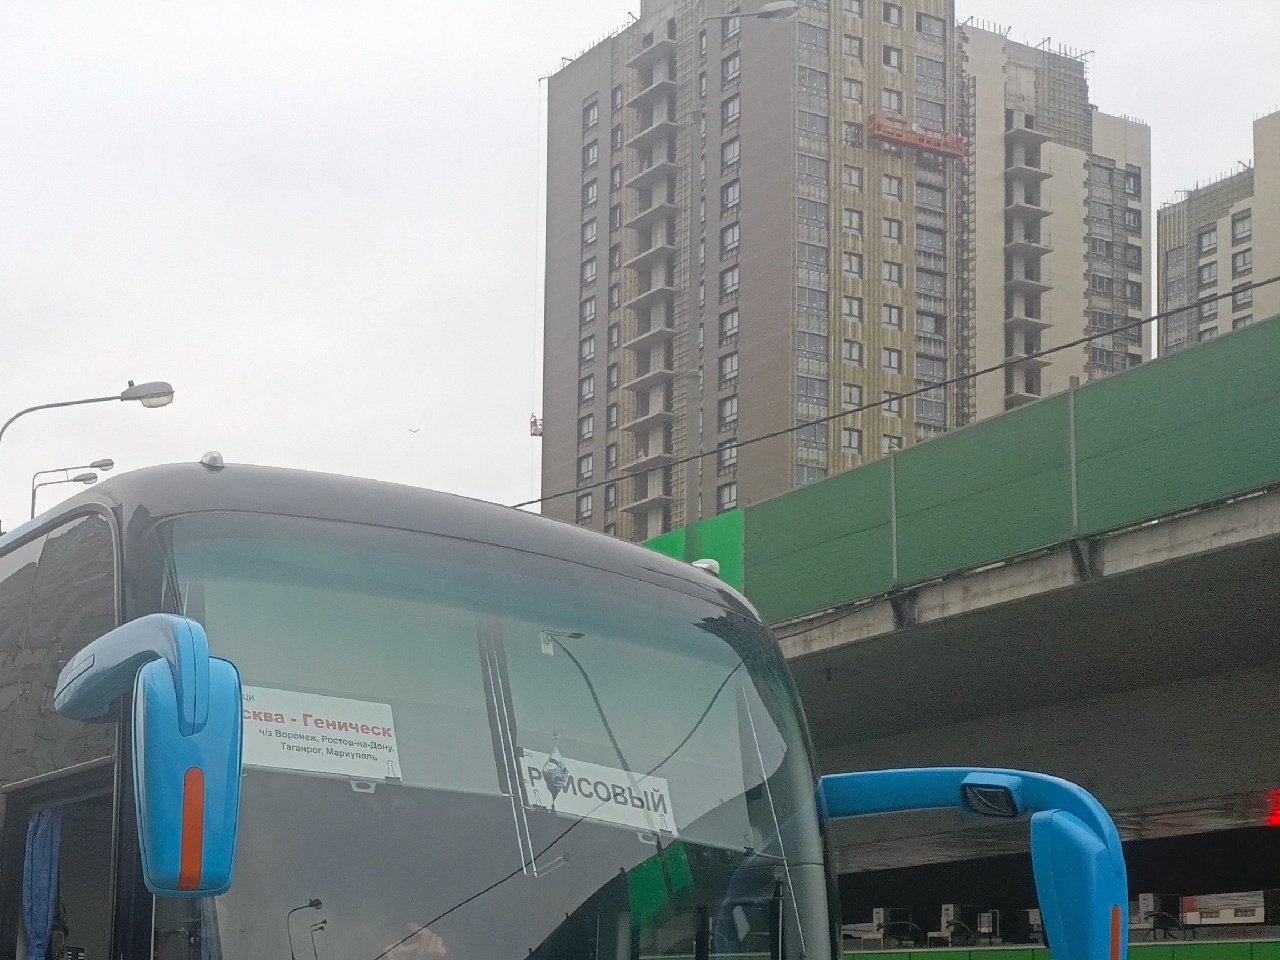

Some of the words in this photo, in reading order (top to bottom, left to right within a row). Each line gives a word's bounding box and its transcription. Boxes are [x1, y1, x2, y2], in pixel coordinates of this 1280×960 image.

[243, 709, 285, 724] сква
[302, 713, 392, 738] Геническ
[259, 728, 273, 737] ч/з
[275, 730, 320, 743] Воронеж,
[321, 735, 395, 752] Ростов-на-Дону,
[280, 742, 324, 756] Таганрог,
[326, 748, 378, 761] Мариуполь
